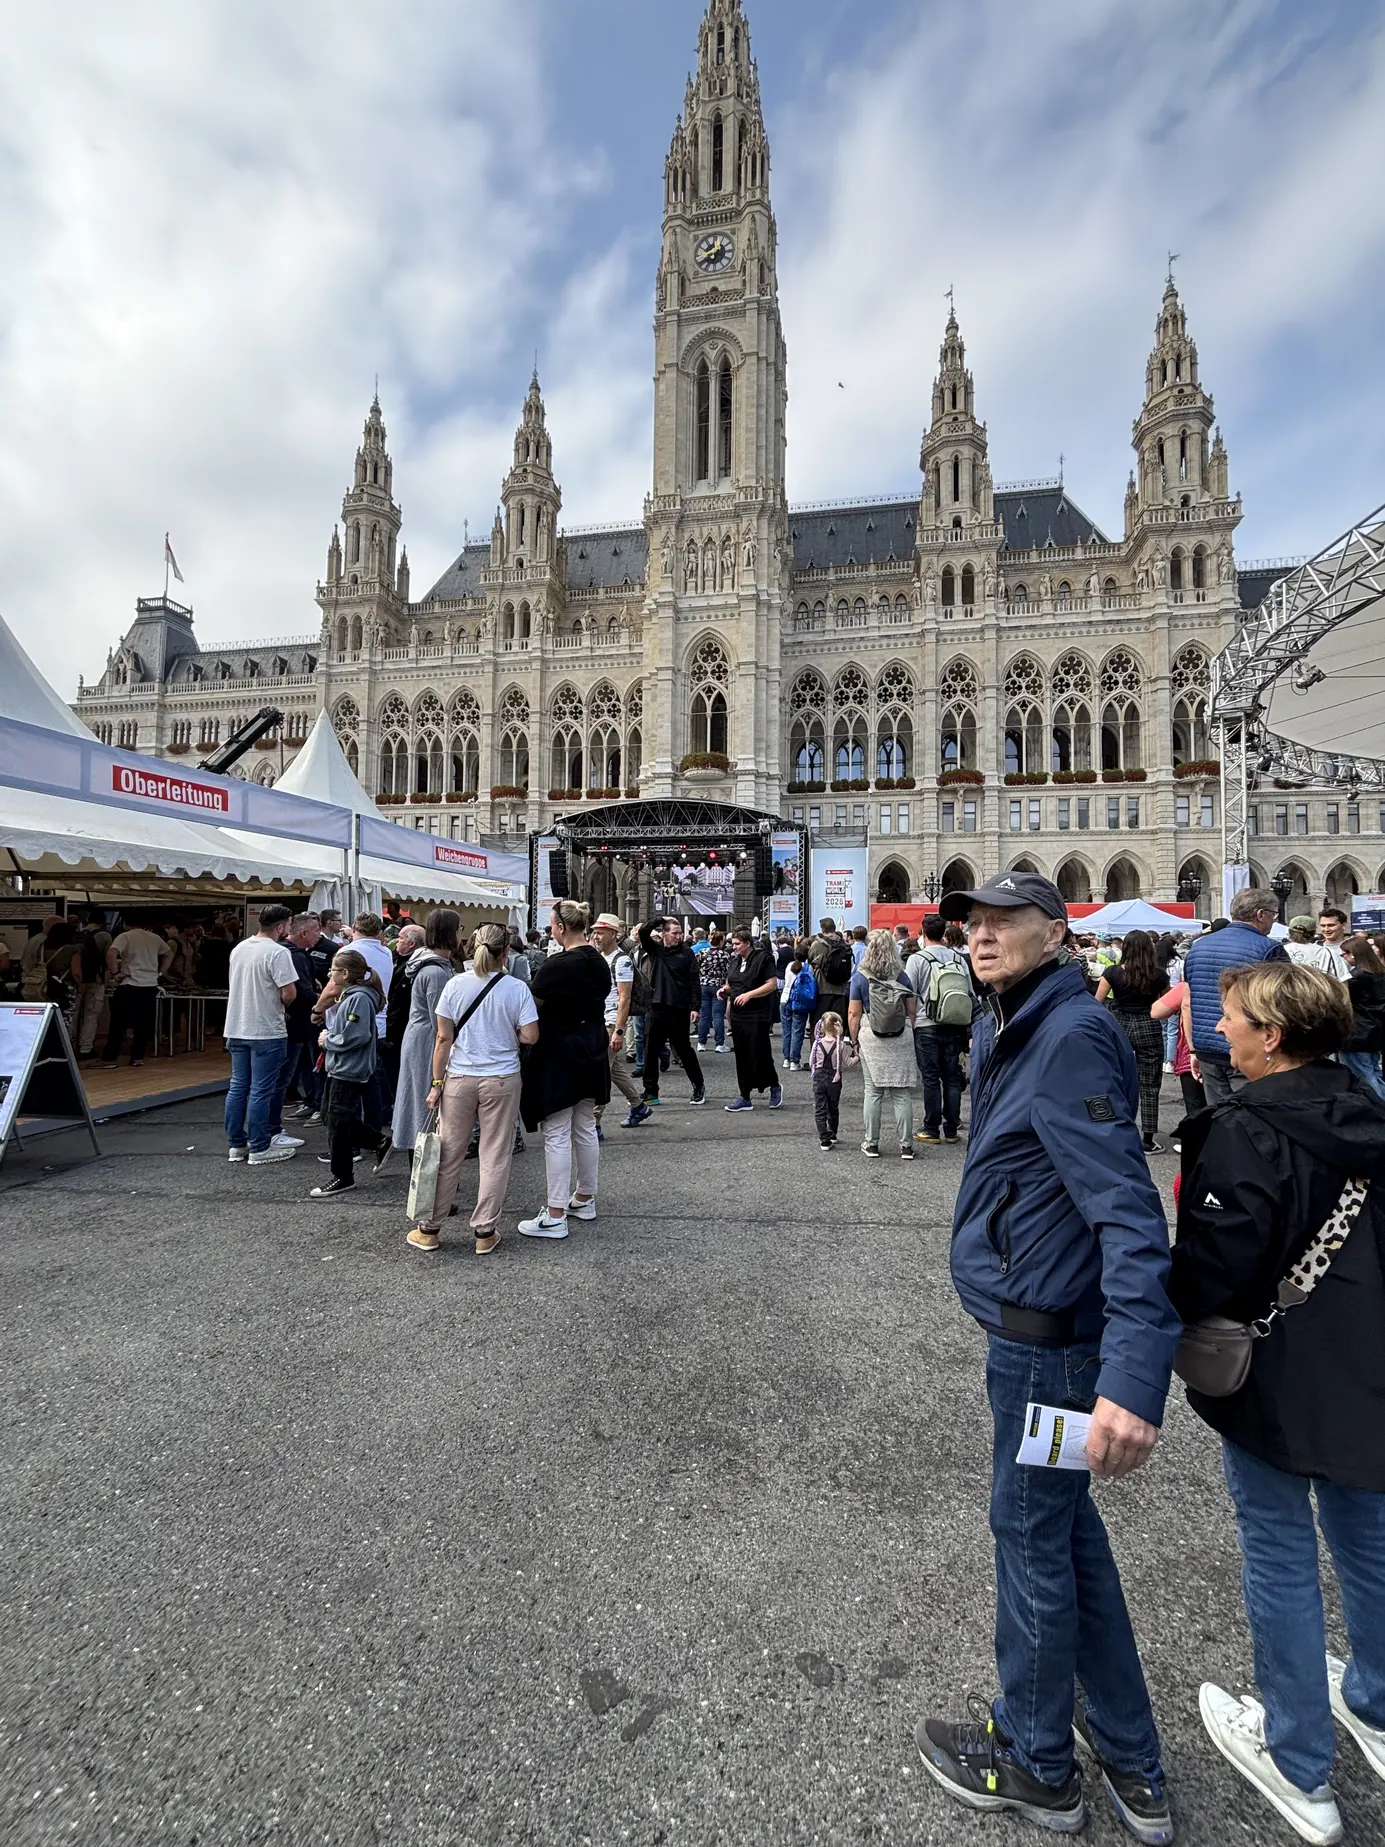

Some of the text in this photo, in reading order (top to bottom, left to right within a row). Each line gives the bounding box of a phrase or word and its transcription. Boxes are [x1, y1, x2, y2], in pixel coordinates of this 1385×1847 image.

[120, 769, 222, 811] Oberleitung
[437, 847, 486, 868] Weichengruppe
[1048, 1416, 1064, 1465] Board please!
